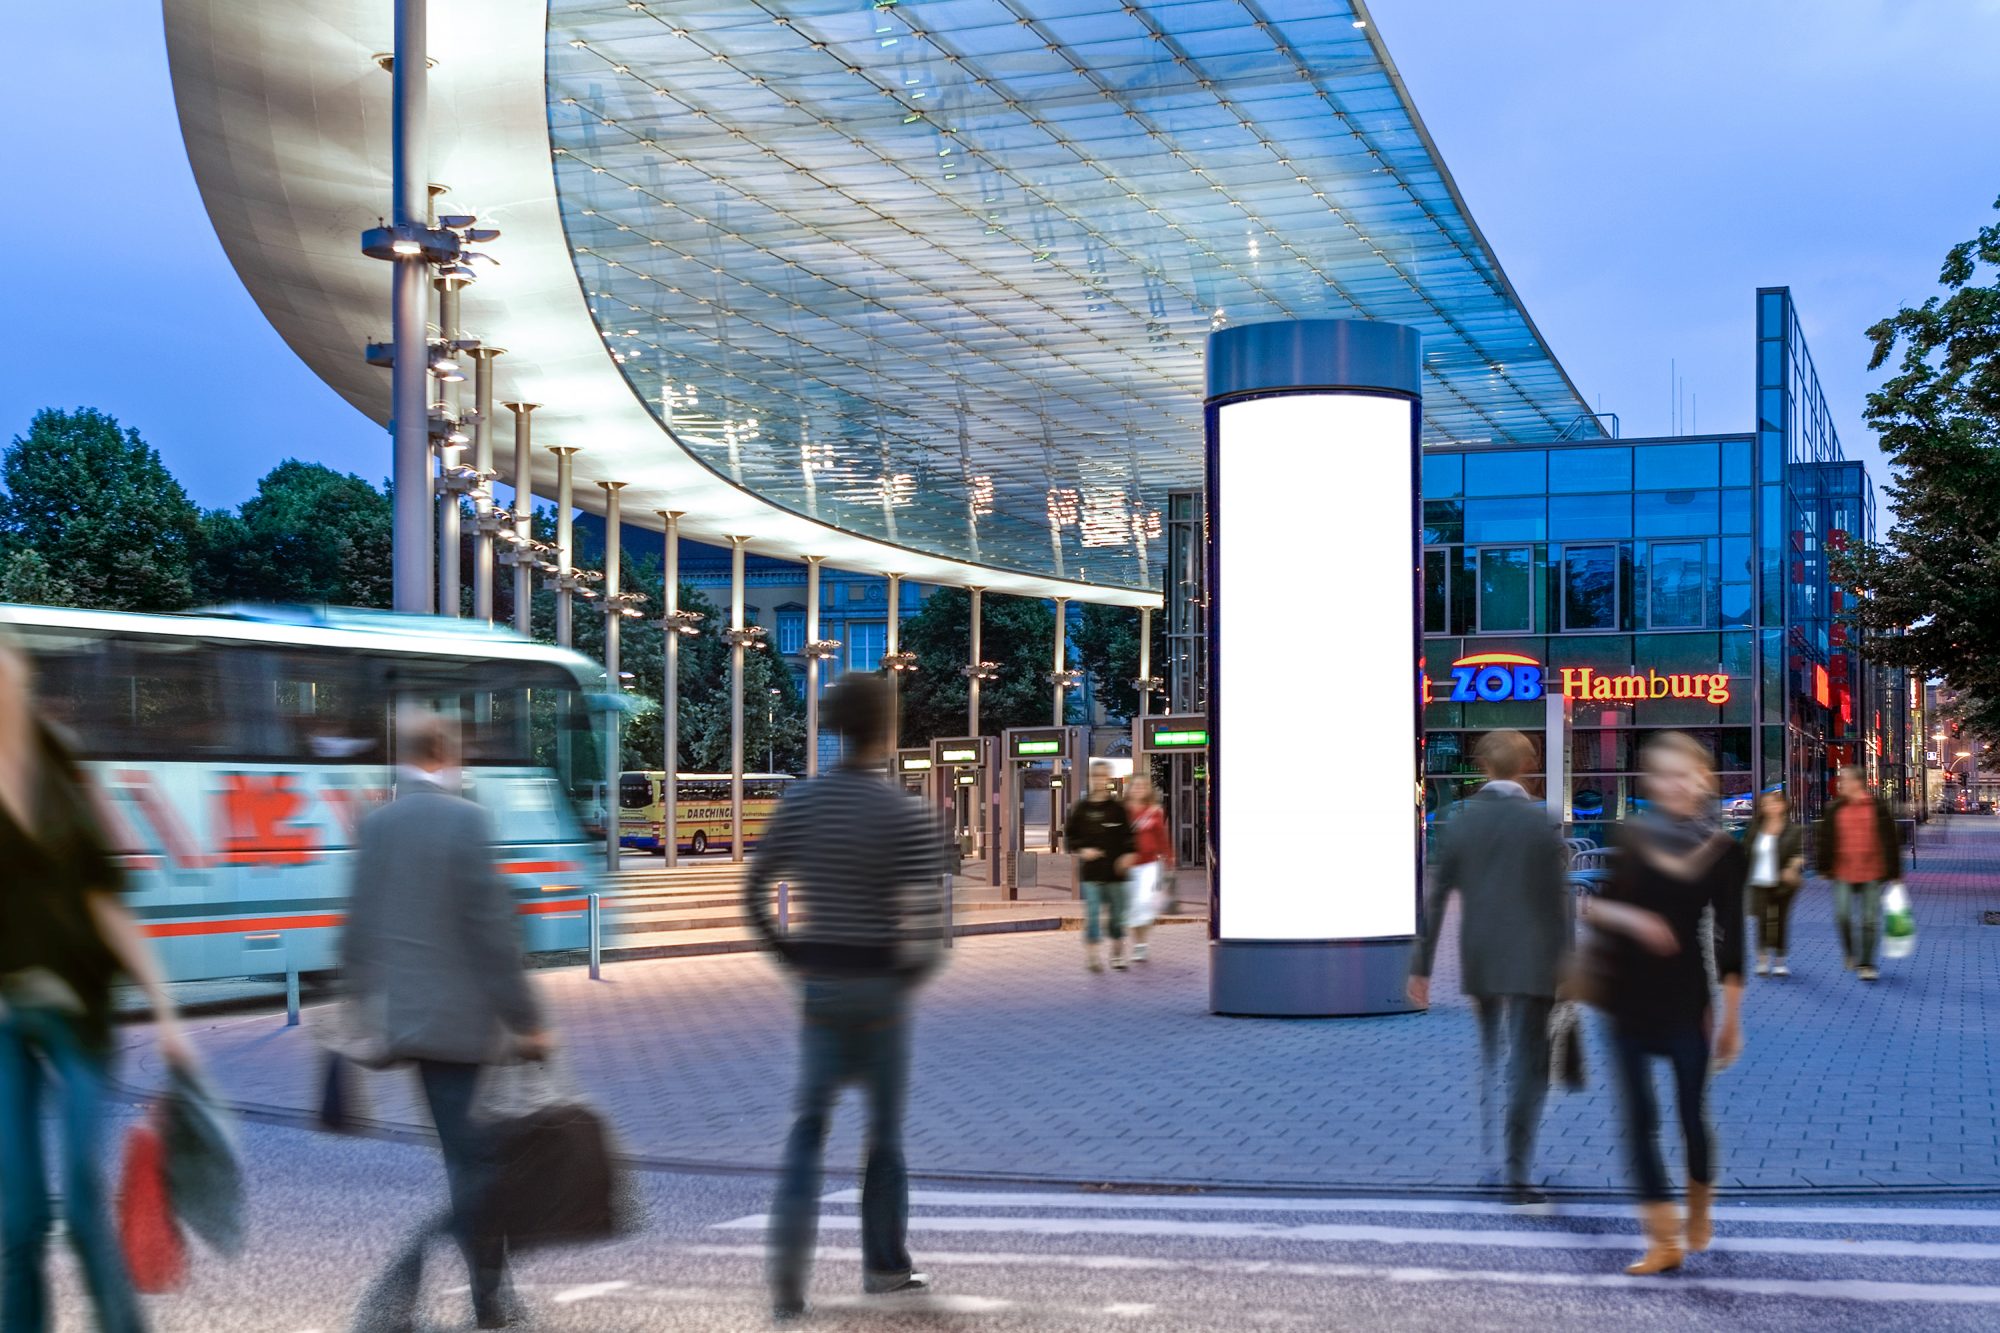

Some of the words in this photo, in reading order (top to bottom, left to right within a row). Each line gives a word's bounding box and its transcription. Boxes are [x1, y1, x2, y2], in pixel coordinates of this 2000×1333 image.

[1449, 665, 1543, 703] ZOB
[1559, 666, 1731, 705] Hamburg
[687, 807, 734, 819] DARCHING
